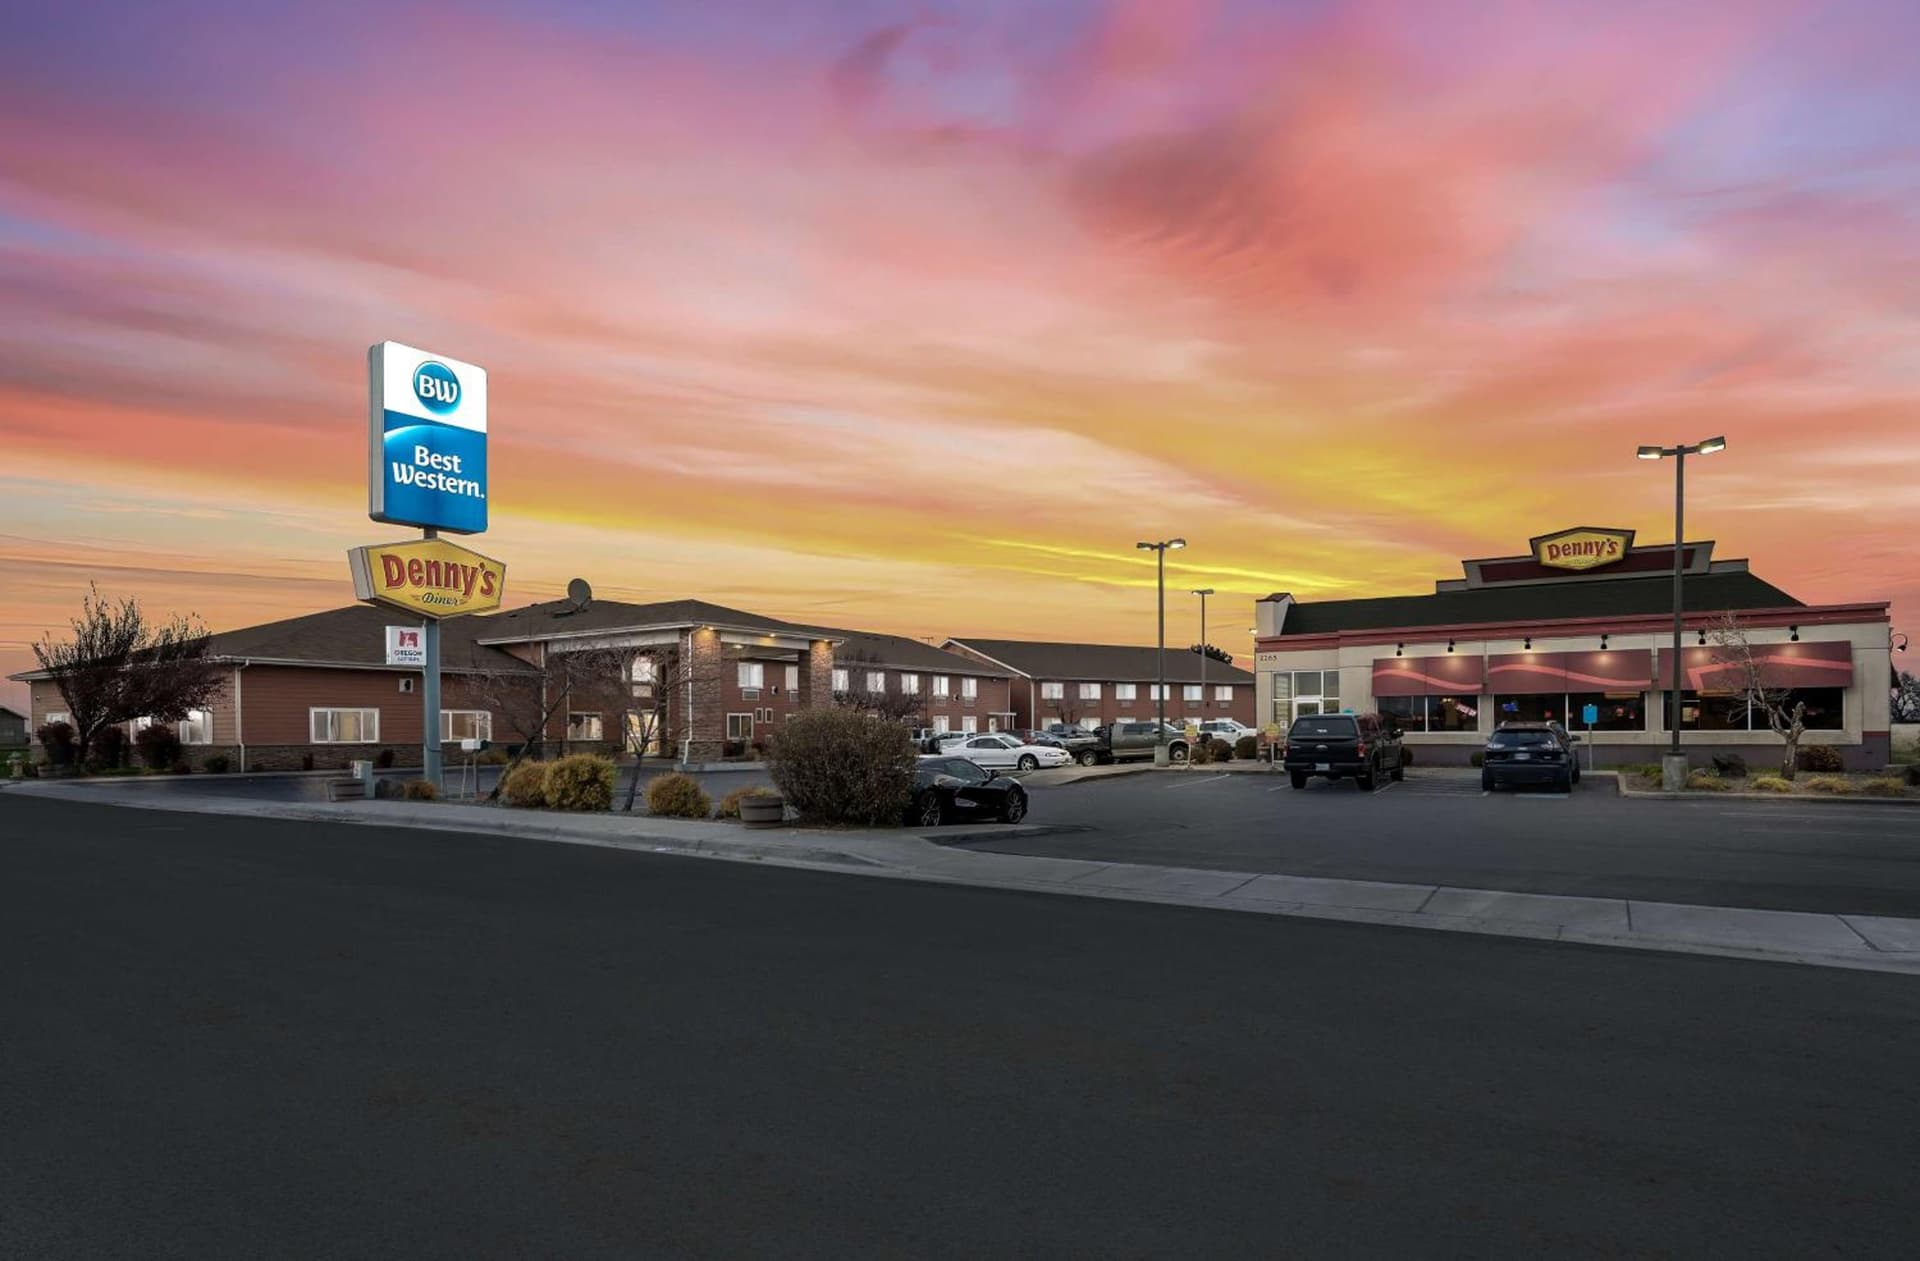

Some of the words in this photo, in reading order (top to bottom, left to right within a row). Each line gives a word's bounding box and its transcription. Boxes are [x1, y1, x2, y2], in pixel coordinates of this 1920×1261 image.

[419, 374, 458, 404] BW
[414, 445, 462, 474] Best
[1547, 538, 1619, 561] Denny's
[380, 554, 496, 597] Denny's
